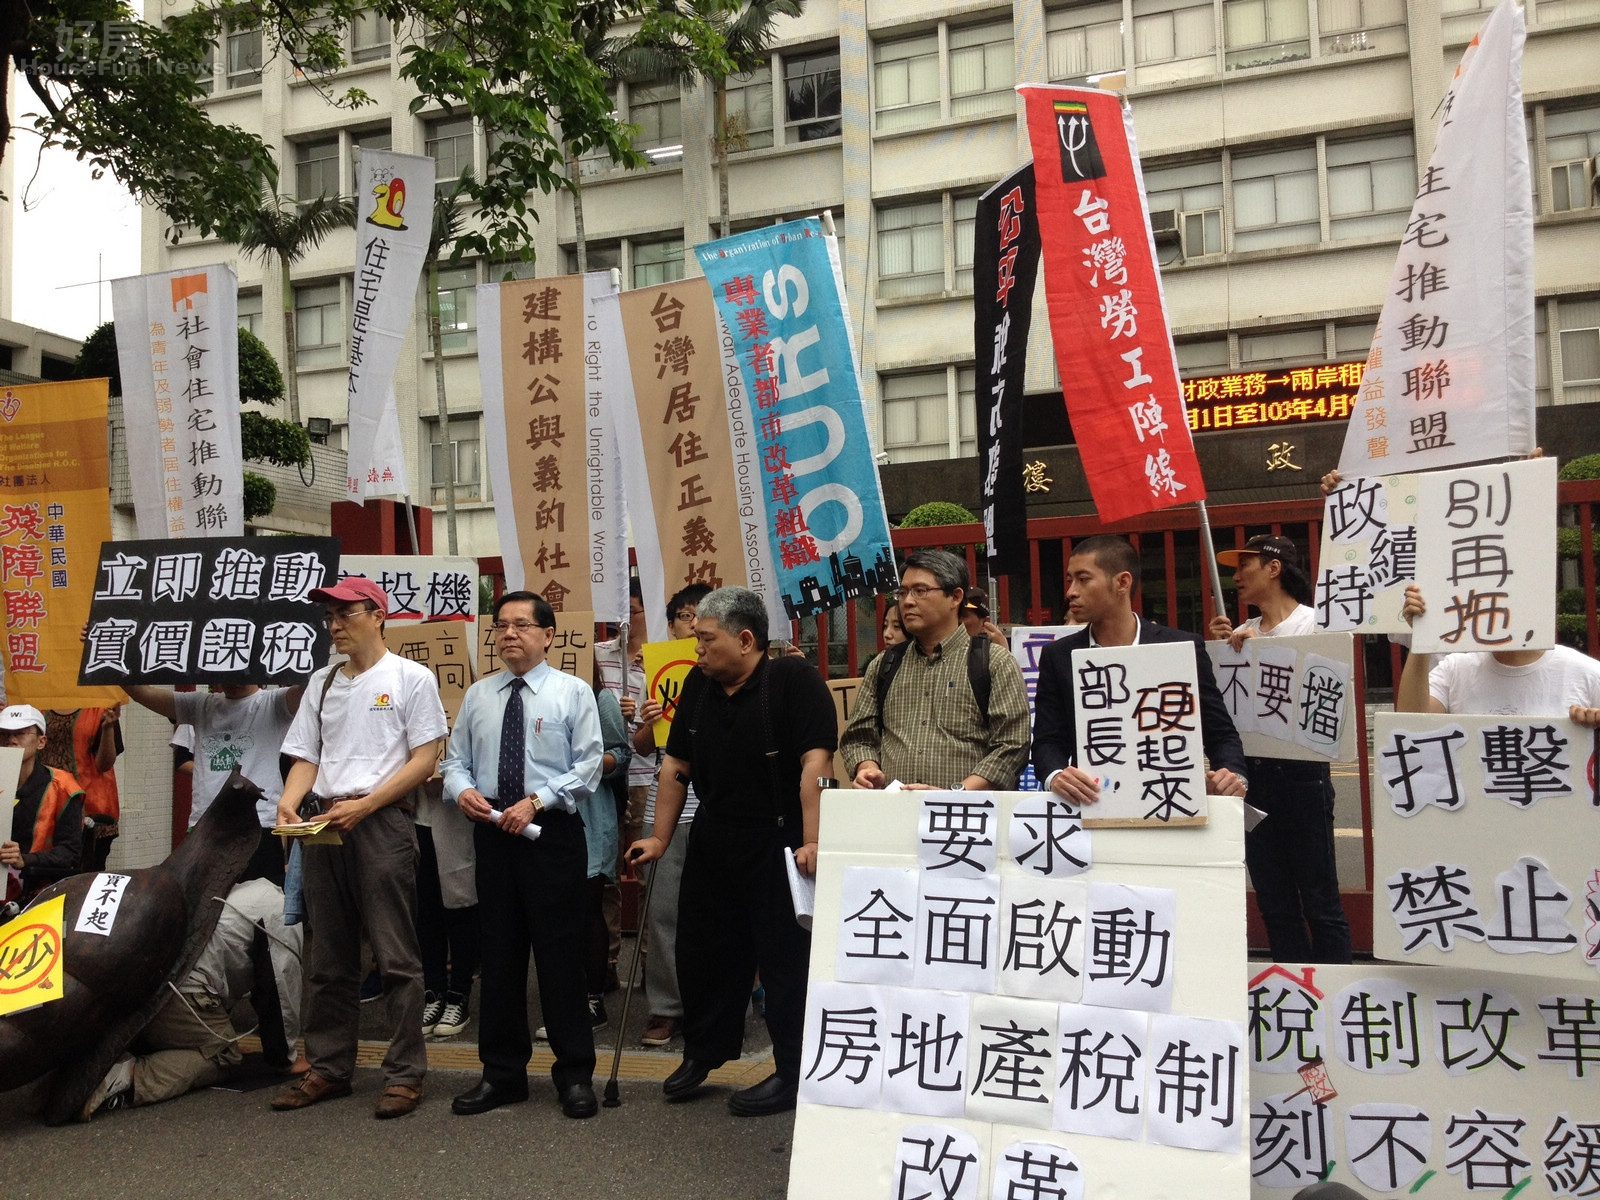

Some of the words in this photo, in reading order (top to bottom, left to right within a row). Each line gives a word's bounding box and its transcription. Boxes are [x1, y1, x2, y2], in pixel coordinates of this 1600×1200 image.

[718, 239, 770, 259] Organization
[771, 235, 780, 245] of
[584, 340, 602, 381] Right
[1073, 189, 1186, 498] 台灣勞工陣線
[1290, 362, 1367, 392] 兩岸租
[149, 321, 187, 540] 為青年及弱勢者居住權益
[175, 314, 229, 531] 社會住宅推動聯
[589, 391, 603, 418] the
[720, 273, 821, 571] 專業者都市改革組織
[725, 363, 748, 448] Adequate
[761, 263, 865, 560] OURS
[586, 427, 605, 521] Unrightable
[736, 450, 755, 516] Housing
[1266, 442, 1302, 471] 政
[47, 502, 68, 588] 中華民國
[96, 551, 325, 602] 立即推動
[590, 530, 606, 584] Wrong
[0, 502, 47, 674] 殘障聯盟
[338, 570, 472, 617] 投機
[86, 617, 316, 674] 實價課稅
[1219, 661, 1344, 742] 不要擋
[1131, 681, 1199, 822] 硬起來
[1382, 723, 1600, 811] 打擊
[921, 799, 1088, 875] 要求
[84, 874, 126, 932] 買不起
[843, 889, 1171, 988] 全面啟動
[1387, 864, 1600, 955] 禁止
[804, 1005, 1239, 1128] 房地產稅制
[1248, 987, 1600, 1078] 稅制改革
[900, 1133, 1081, 1200] 改革
[1250, 1101, 1600, 1199] 刻不容緩
